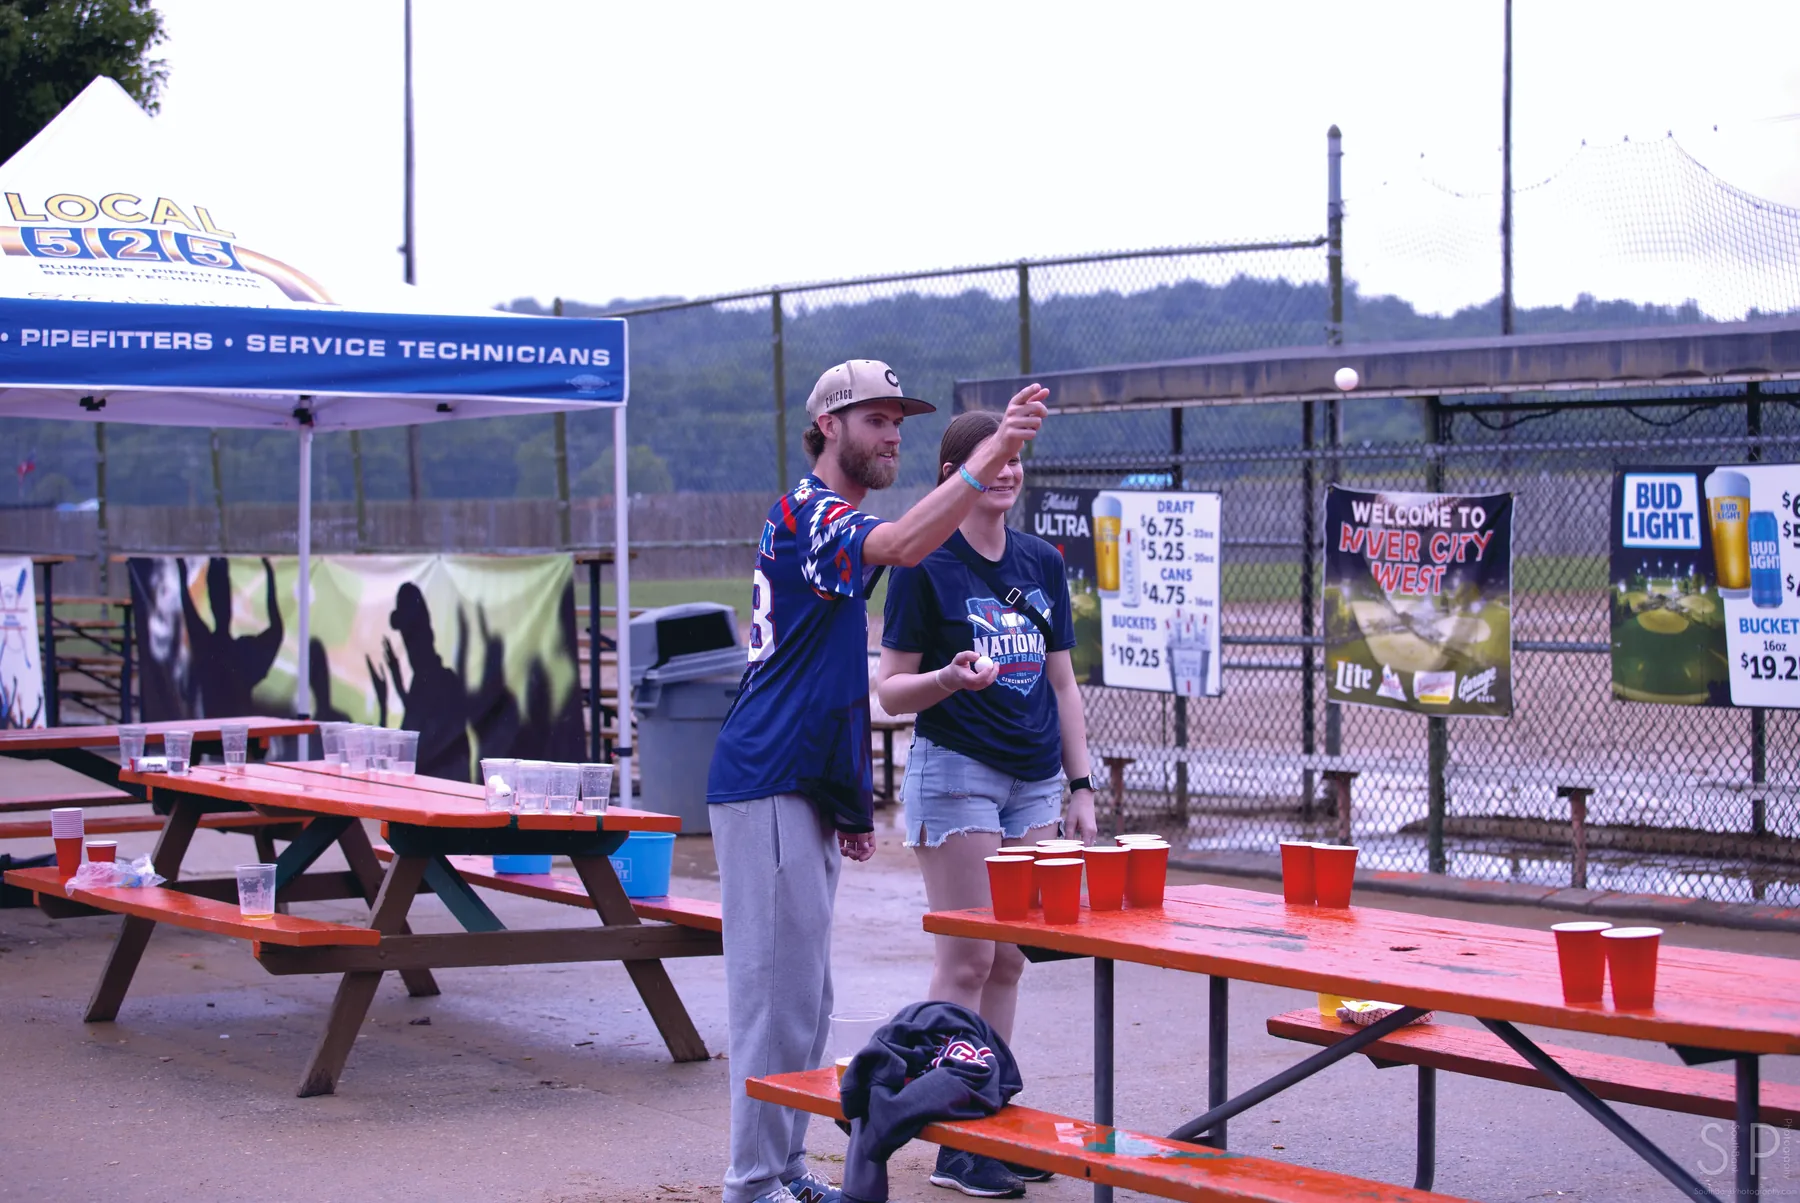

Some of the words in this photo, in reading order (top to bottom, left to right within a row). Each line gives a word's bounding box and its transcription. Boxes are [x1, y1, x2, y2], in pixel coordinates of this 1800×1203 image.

[4, 192, 236, 239] LOCAL
[21, 329, 213, 350] PIPEFITTERS
[246, 333, 386, 357] SERVICE
[398, 340, 610, 366] TECHNICIANS
[884, 369, 899, 388] C
[825, 389, 853, 408] CHICAGO
[1157, 500, 1195, 514] DRAFT
[1636, 482, 1683, 510] BUD
[1720, 503, 1738, 511] BUD
[1034, 513, 1091, 538] ULTRA
[1140, 514, 1184, 537] $6.75
[1351, 501, 1452, 528] WELCOME
[1458, 506, 1486, 529] TO
[1627, 512, 1694, 540] LIGHT
[1141, 538, 1185, 562] $5.25
[1339, 521, 1420, 562] RIVER
[1430, 530, 1494, 563] CITY
[1751, 541, 1776, 555] BUD
[1160, 568, 1193, 581] CANS
[1371, 561, 1447, 597] WEST
[1143, 581, 1185, 605] $4.75
[1112, 614, 1157, 630] BUCKETS
[973, 633, 1047, 661] NATIONA
[1111, 642, 1160, 668] $19.25
[1763, 640, 1787, 651] 16oz
[1334, 660, 1373, 694] Lite
[1741, 653, 1800, 680] $19.2
